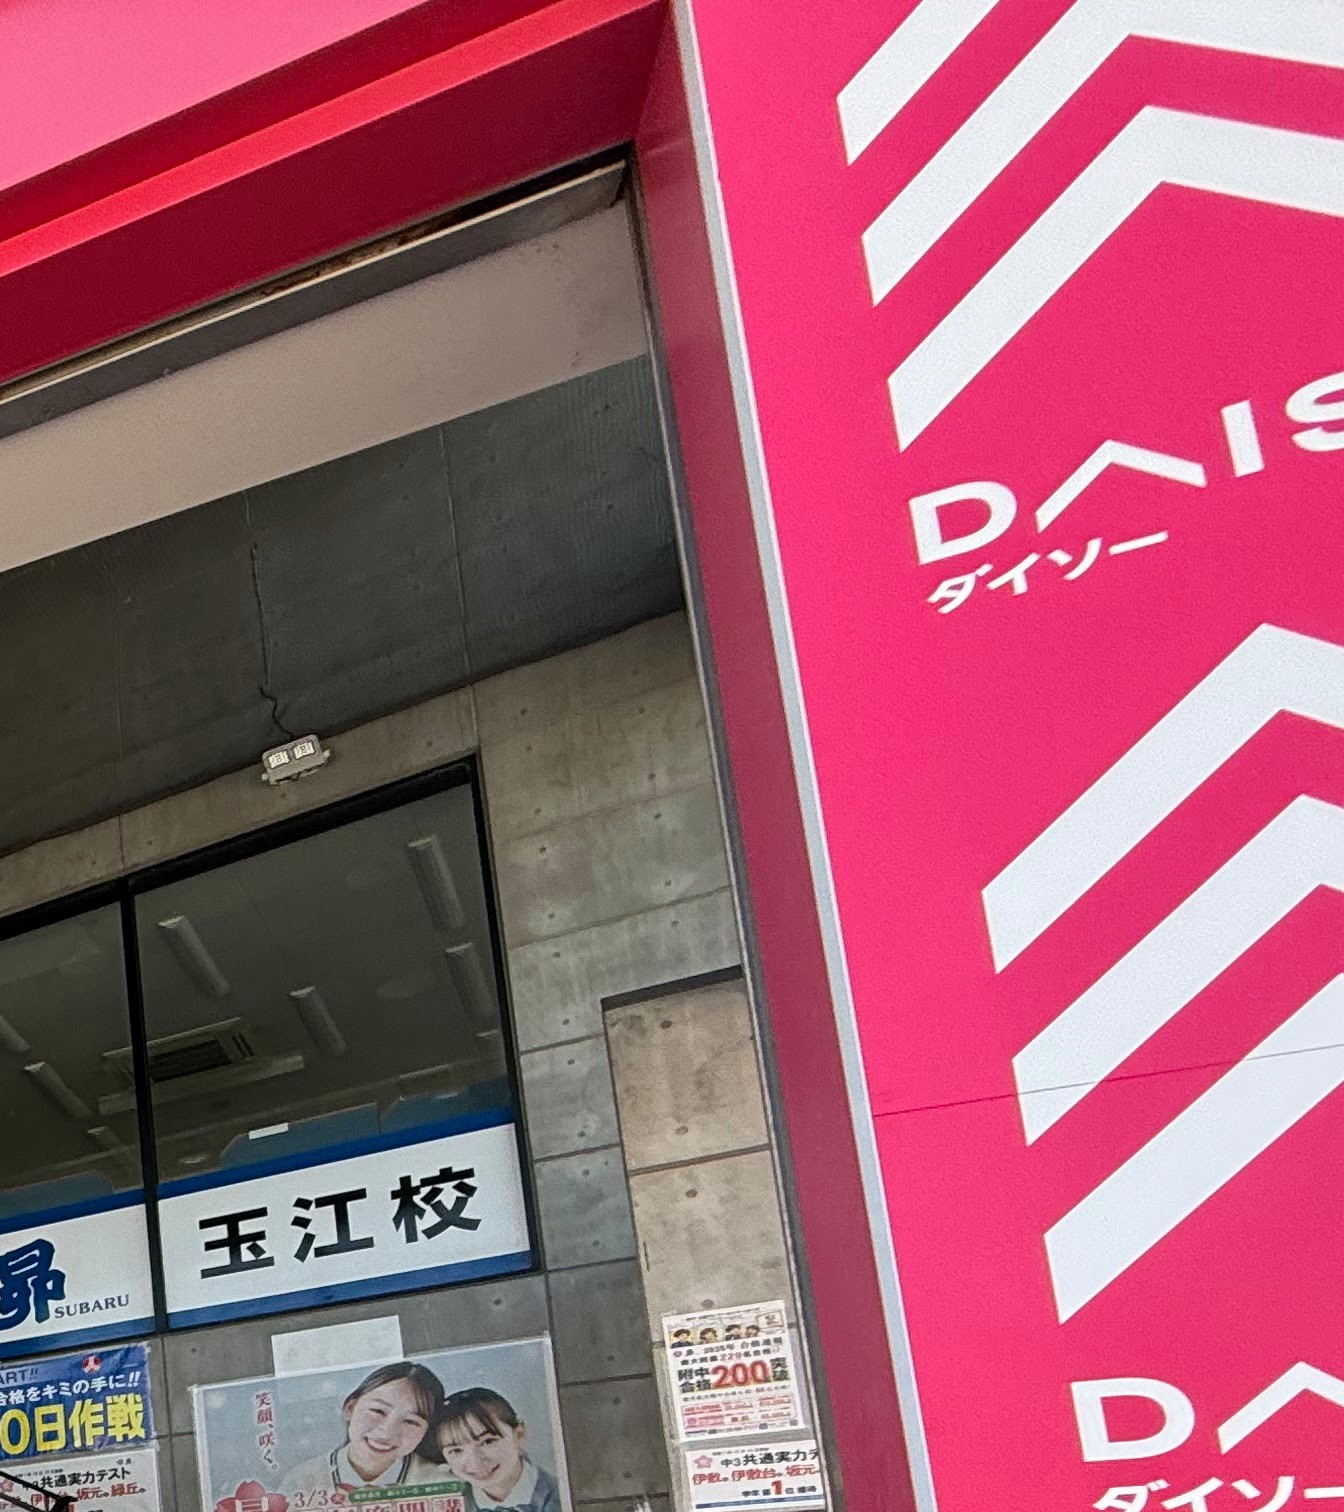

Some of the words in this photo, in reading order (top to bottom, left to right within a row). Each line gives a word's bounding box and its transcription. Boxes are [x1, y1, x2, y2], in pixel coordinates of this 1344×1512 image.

[928, 530, 1169, 614] ダイソー
[198, 1166, 482, 1280] 玉江校
[54, 1294, 130, 1319] SUBARU
[711, 1360, 773, 1388] 200
